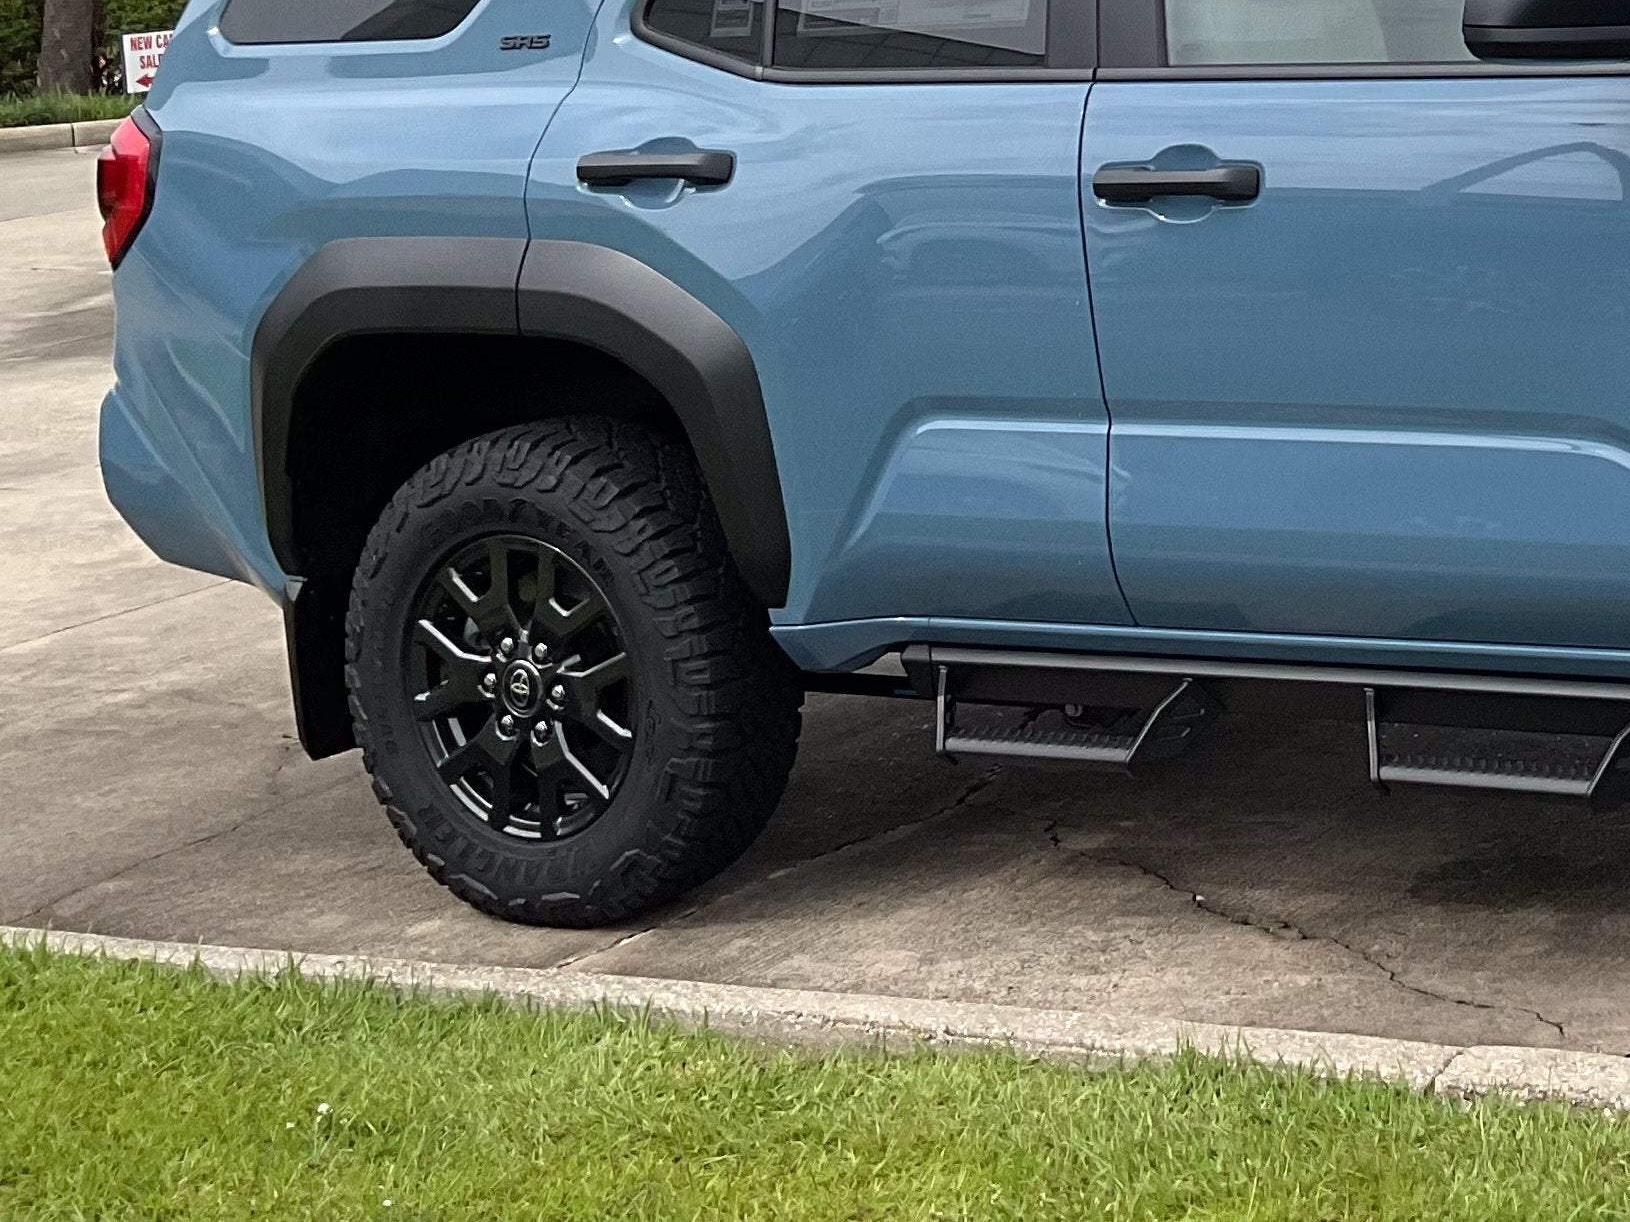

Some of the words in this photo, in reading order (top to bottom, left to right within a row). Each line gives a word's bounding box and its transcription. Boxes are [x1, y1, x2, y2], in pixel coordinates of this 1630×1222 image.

[130, 35, 152, 51] NEW
[156, 33, 173, 49] CA
[499, 33, 552, 51] SR5
